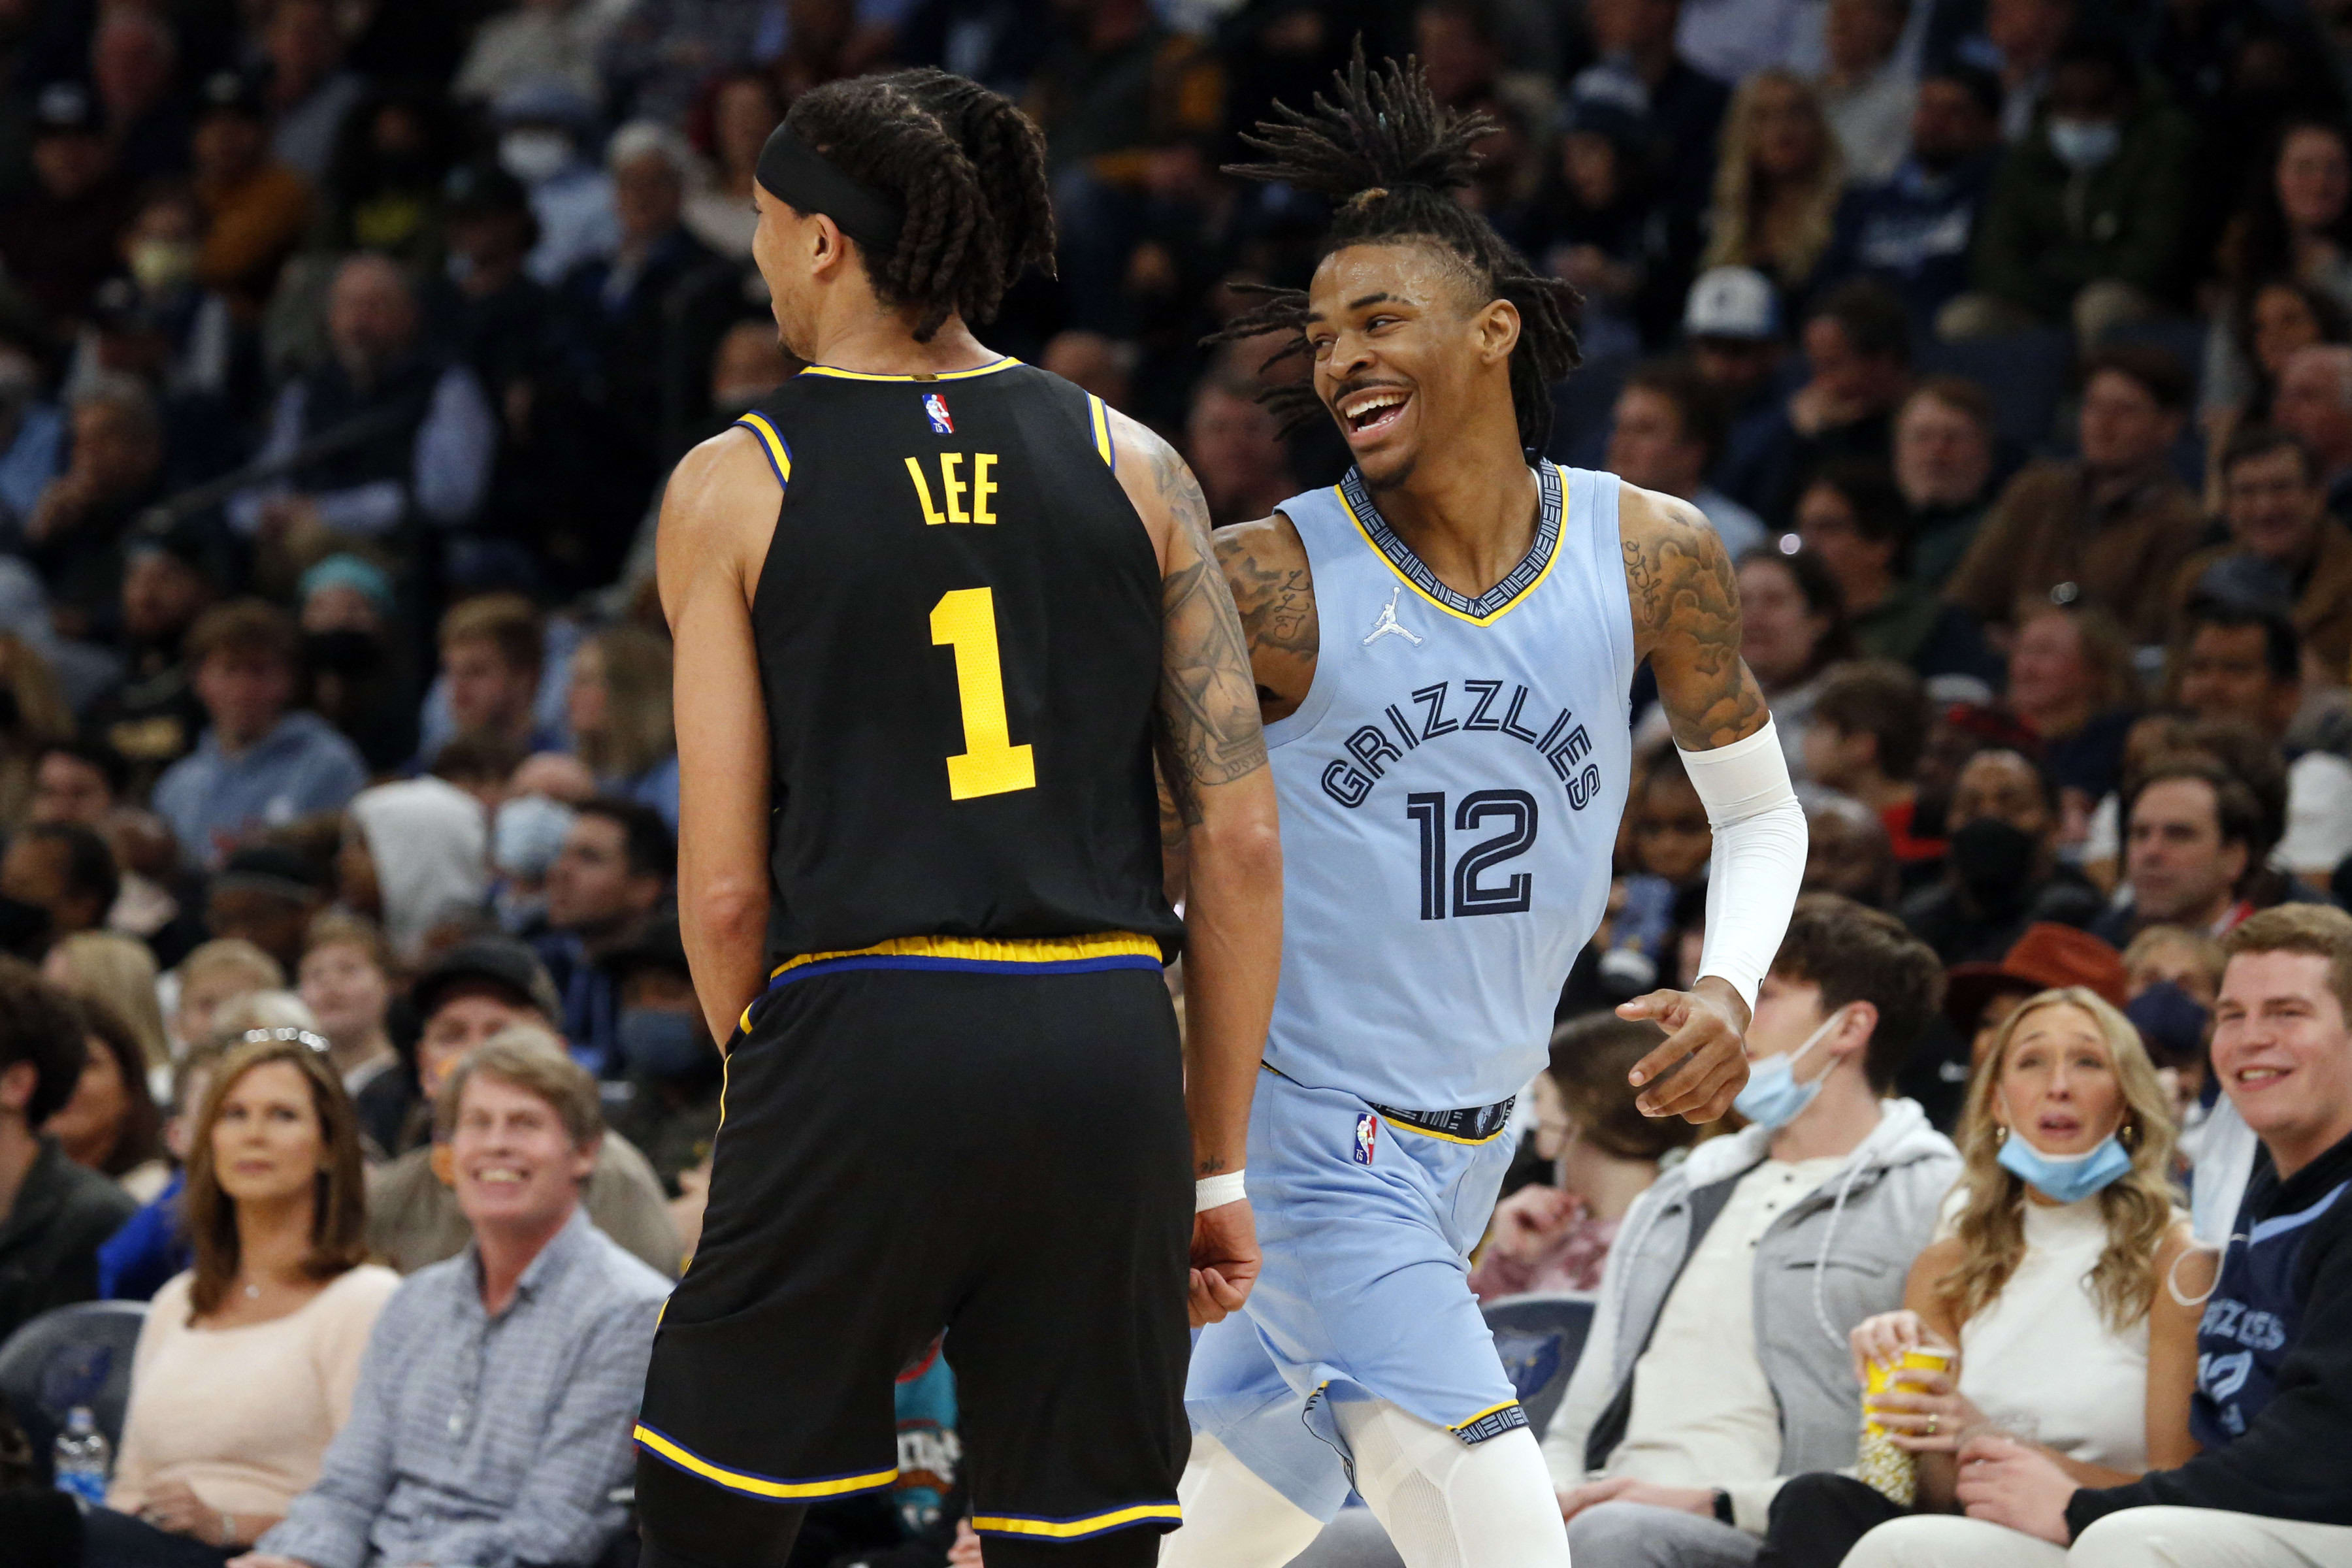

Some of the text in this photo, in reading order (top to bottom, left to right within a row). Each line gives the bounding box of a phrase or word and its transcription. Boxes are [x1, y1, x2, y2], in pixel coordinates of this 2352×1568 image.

[934, 423, 943, 433] 75
[905, 452, 998, 525] LEE
[929, 586, 1036, 801] 1
[1320, 679, 1601, 811] GRIZZLIES
[1407, 788, 1539, 921] 12
[1356, 1149, 1364, 1161] 75
